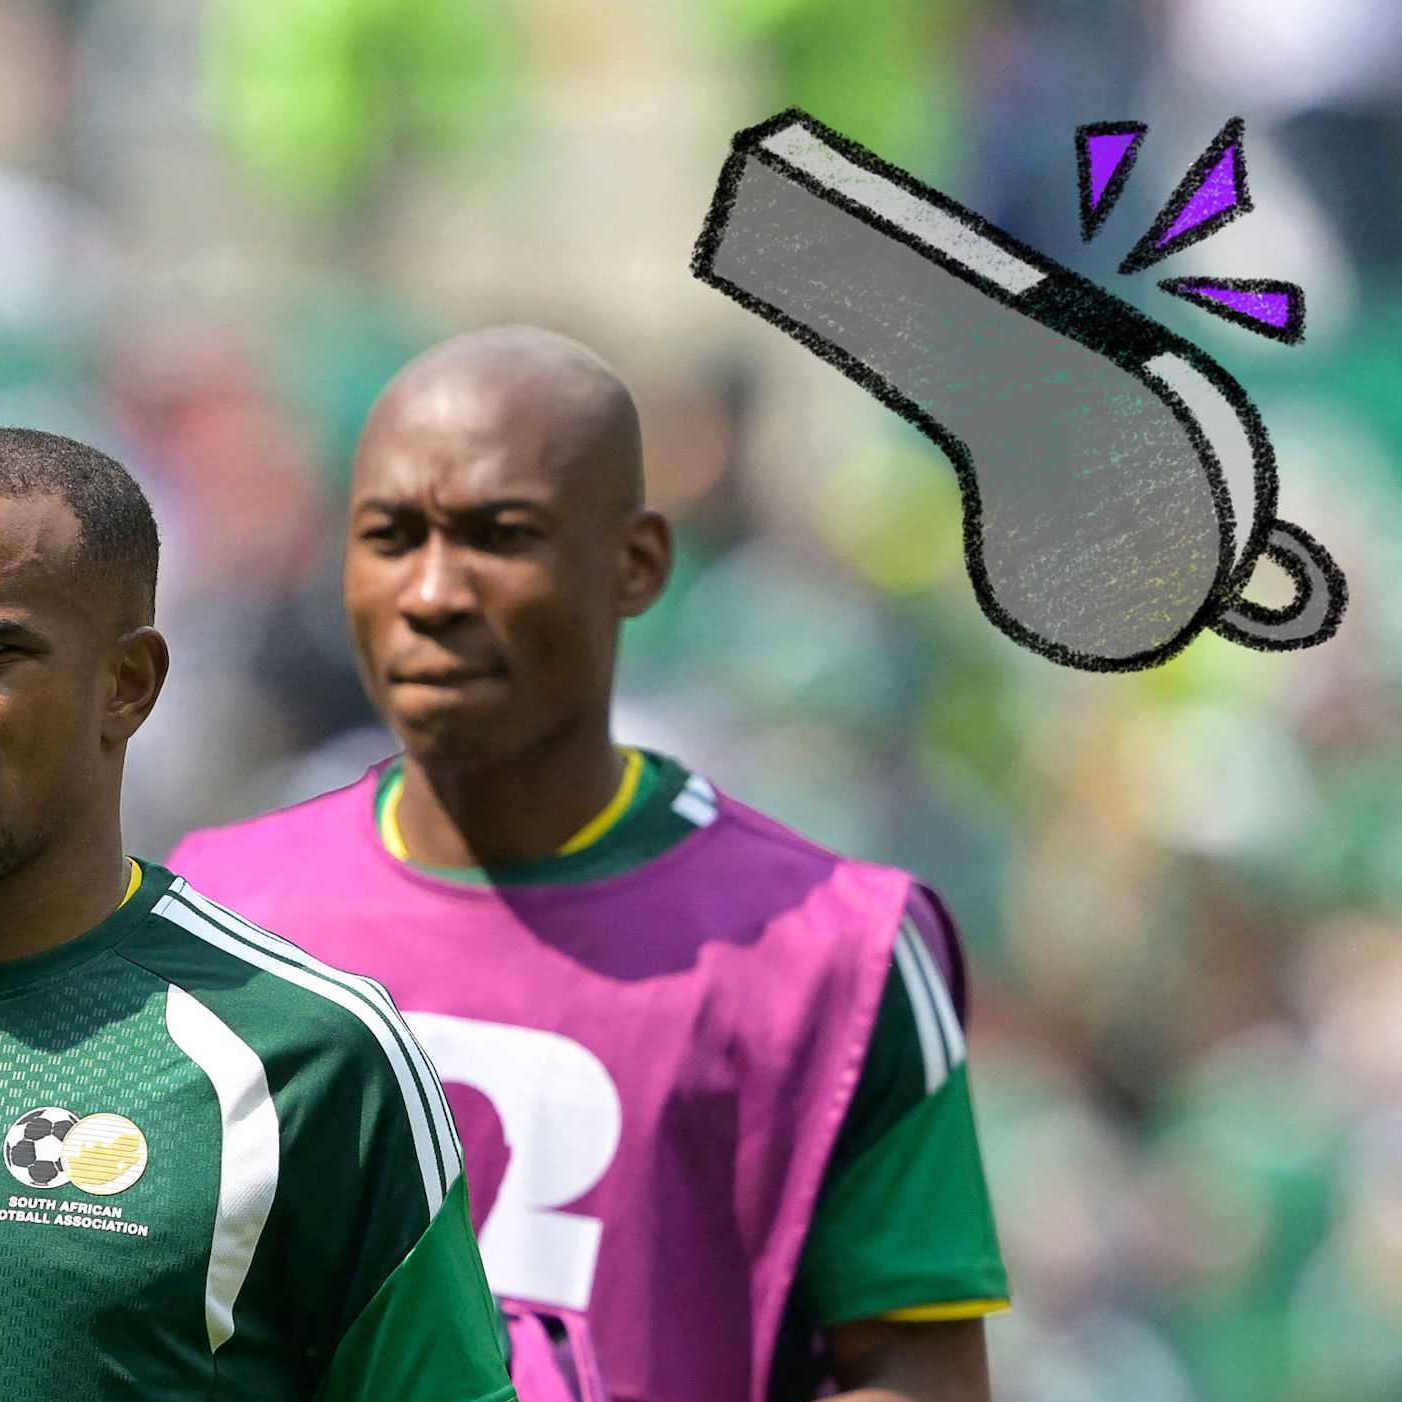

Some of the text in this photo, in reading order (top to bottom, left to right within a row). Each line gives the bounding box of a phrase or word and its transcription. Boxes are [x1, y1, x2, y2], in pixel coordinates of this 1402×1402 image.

[8, 1195, 123, 1219] SOUTH AFRICAN
[53, 1214, 149, 1237] ASSOCIATION
